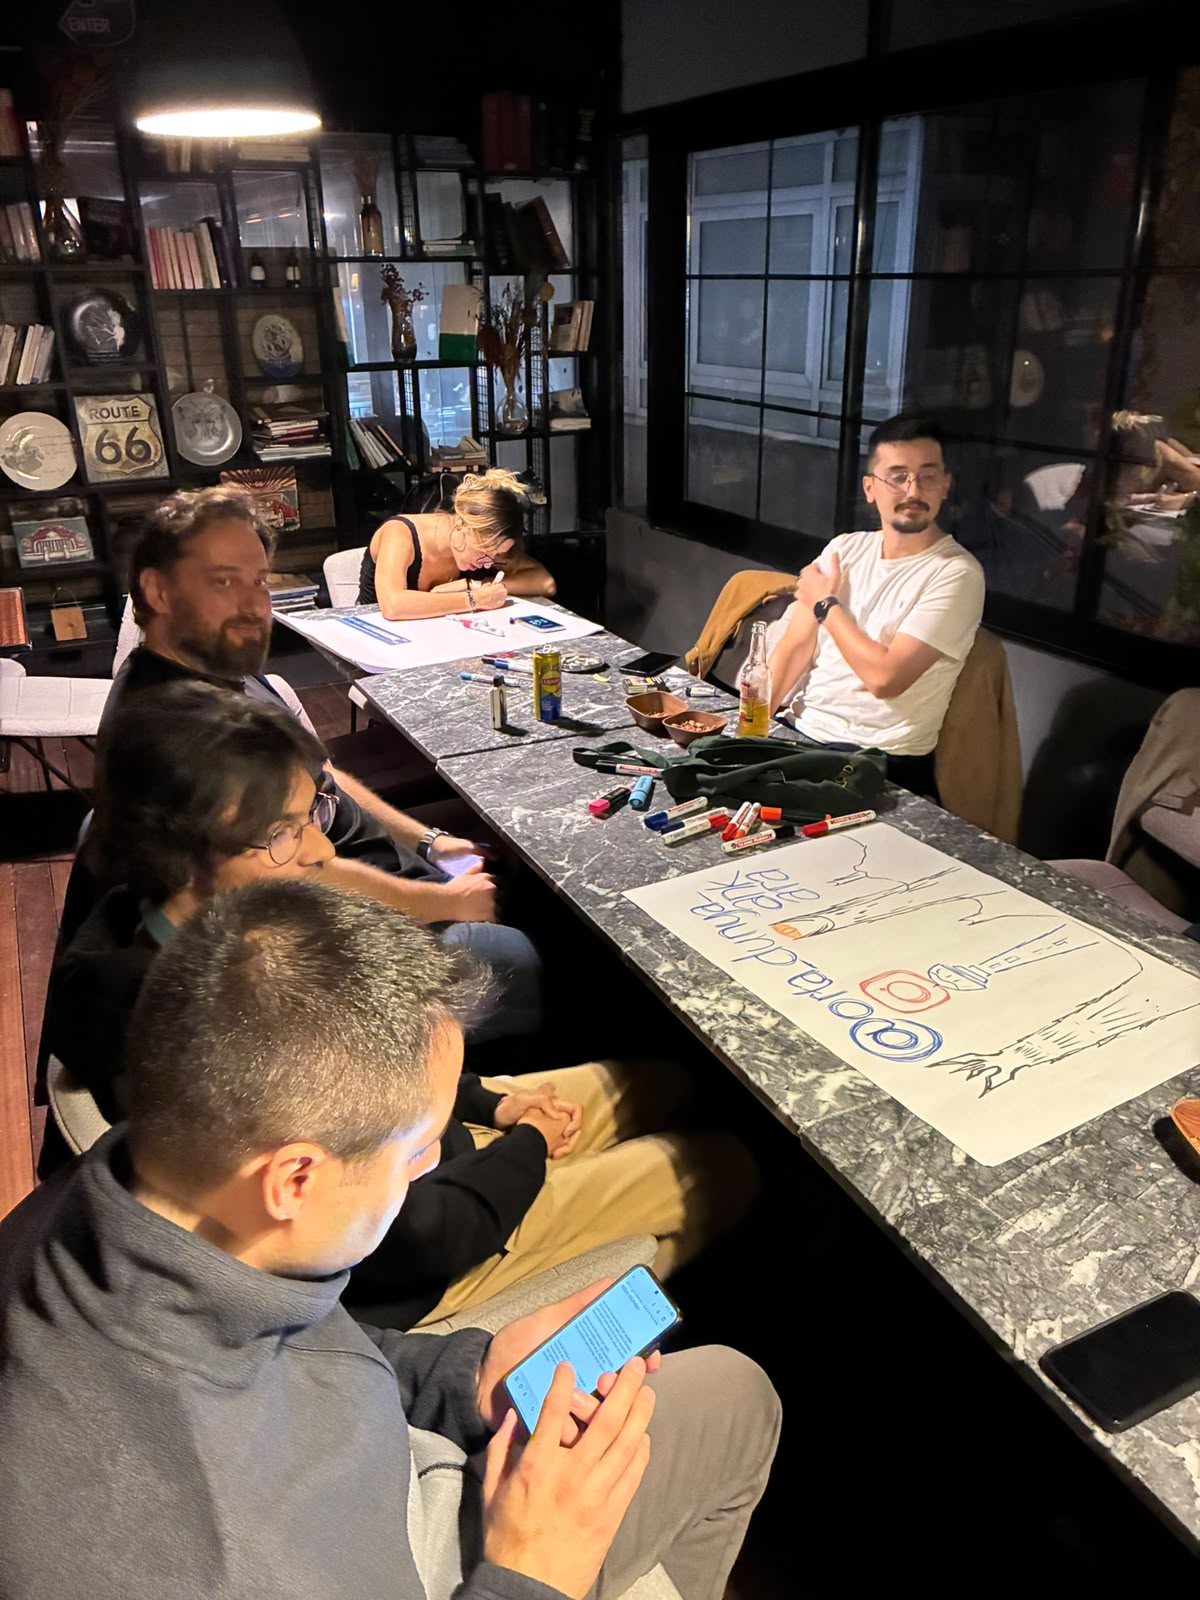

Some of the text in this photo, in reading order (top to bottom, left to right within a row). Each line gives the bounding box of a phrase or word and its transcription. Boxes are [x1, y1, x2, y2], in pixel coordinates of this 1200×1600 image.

[67, 16, 111, 33] ENTER
[89, 405, 140, 420] ROUTE
[95, 425, 152, 465] 66
